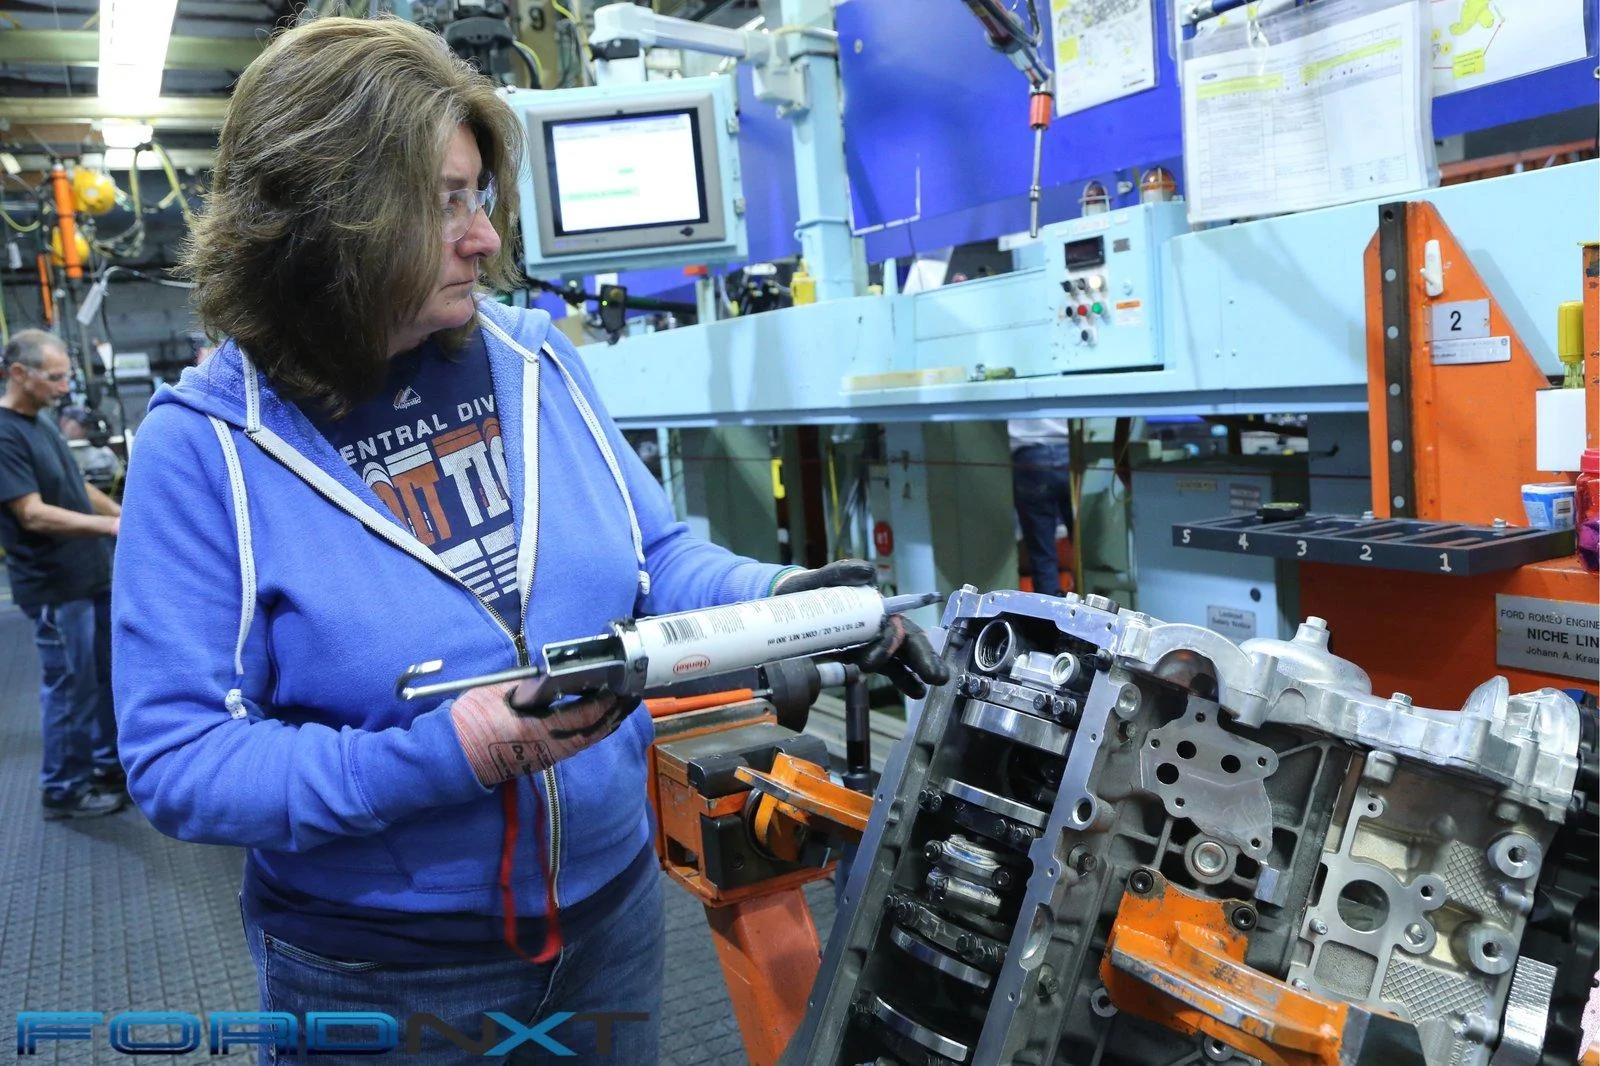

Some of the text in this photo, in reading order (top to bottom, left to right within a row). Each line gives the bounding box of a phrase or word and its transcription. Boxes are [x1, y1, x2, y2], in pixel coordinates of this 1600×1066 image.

[529, 6, 545, 31] 9
[1450, 310, 1462, 332] 2
[393, 397, 422, 411] Majestic
[339, 394, 495, 465] ENTRAL DIV
[1182, 528, 1452, 573] 5 4 3 2 1
[1500, 609, 1524, 620] FORD
[1528, 612, 1562, 625] ROMEO
[1527, 627, 1569, 644] NICHE
[1526, 646, 1558, 659] Johann
[1562, 651, 1572, 661] A.
[675, 659, 708, 672] Henkel
